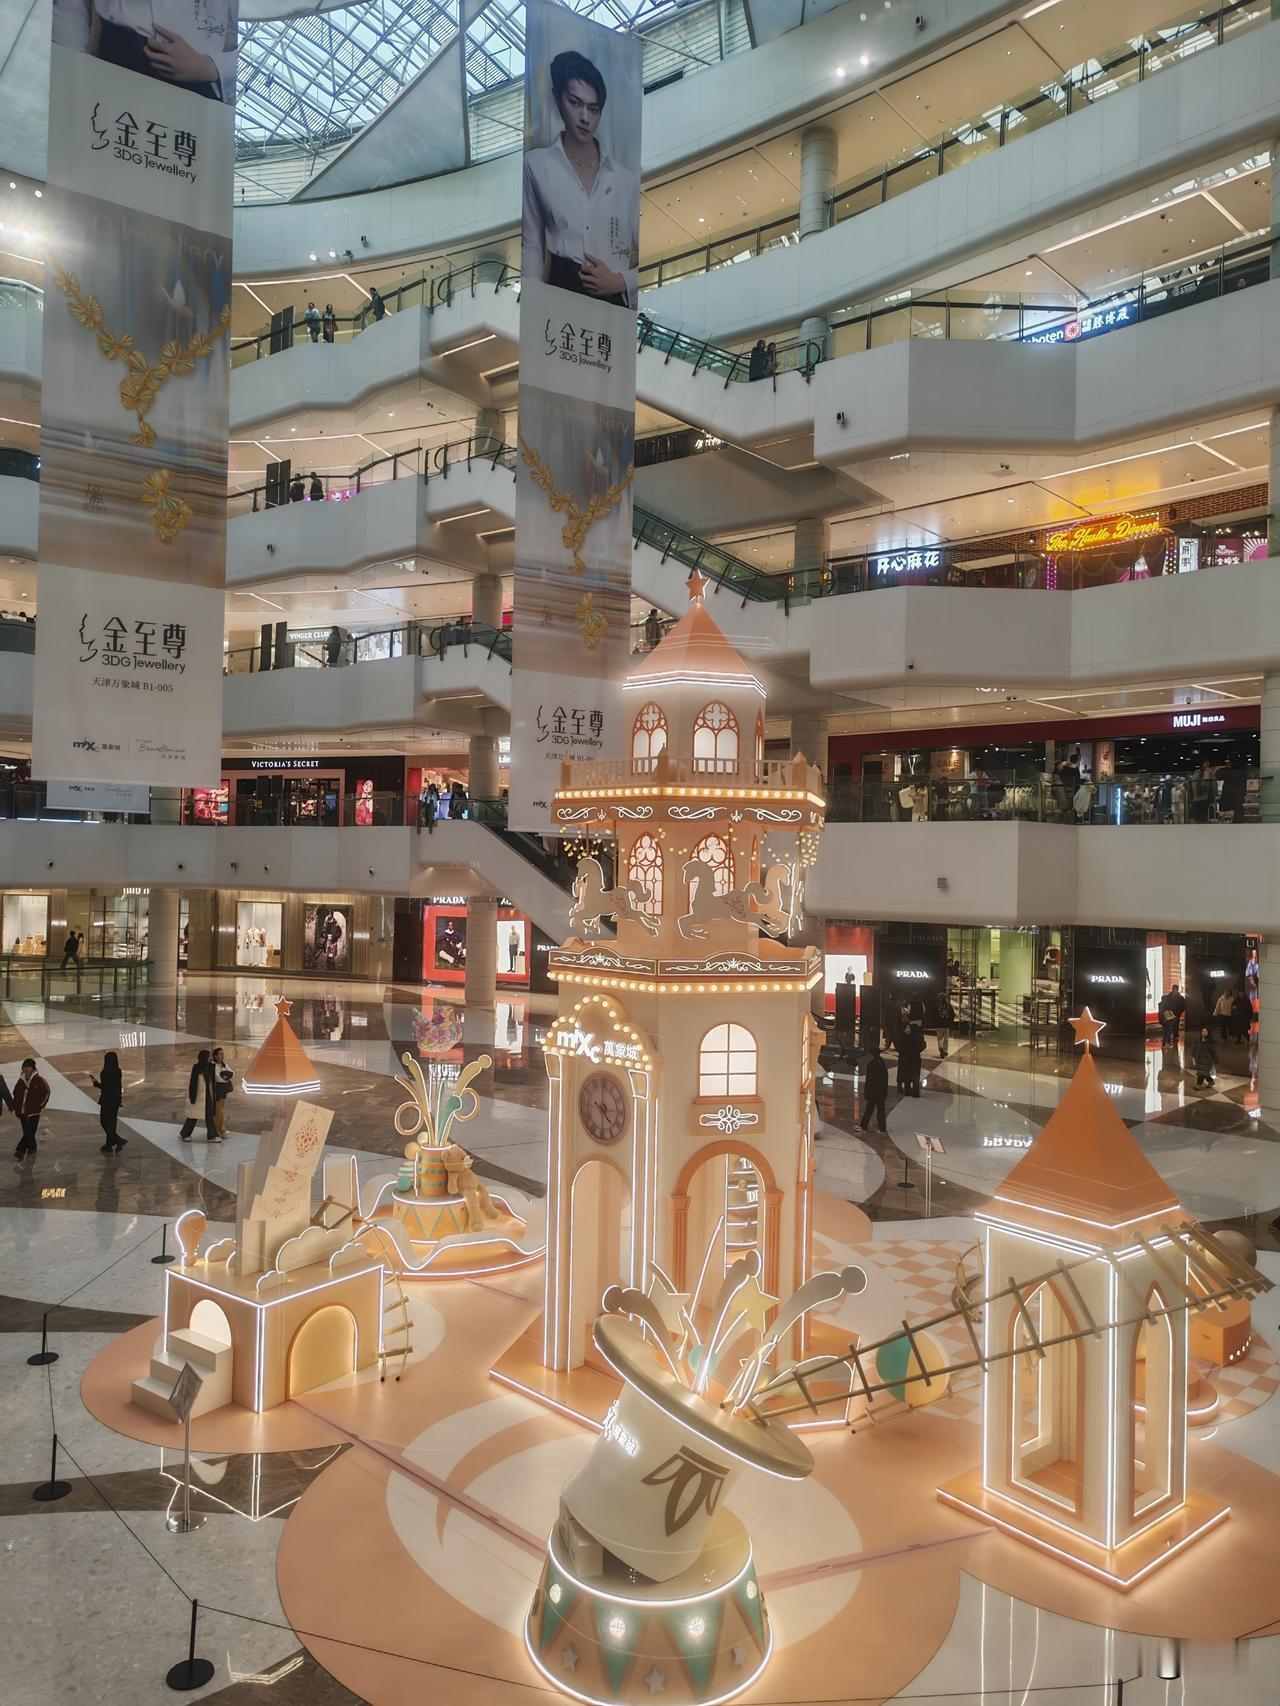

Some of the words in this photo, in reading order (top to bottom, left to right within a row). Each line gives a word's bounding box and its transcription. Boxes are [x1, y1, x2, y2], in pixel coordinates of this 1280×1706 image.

[113, 111, 197, 168] 金至尊
[113, 146, 143, 165] 3DG
[144, 154, 197, 184] Jewellery
[559, 322, 613, 362] 金至尊
[559, 350, 578, 363] 3DG
[1046, 533, 1069, 551] The
[1071, 527, 1111, 547] Hustle
[101, 616, 187, 659] 金至尊
[101, 654, 131, 668] 3DG
[132, 655, 186, 675] Jewellery
[92, 677, 141, 690] 天津万象城
[143, 682, 174, 693] B1-005
[551, 706, 604, 738] 金至尊
[1173, 714, 1201, 728] MUJI
[551, 735, 570, 745] 3DG
[571, 735, 604, 750] Jewellery
[293, 760, 320, 768] SECRET
[936, 759, 960, 768] SALE
[433, 896, 466, 905] PRADA
[896, 970, 929, 978] PRADA
[1091, 975, 1125, 983] PRADA
